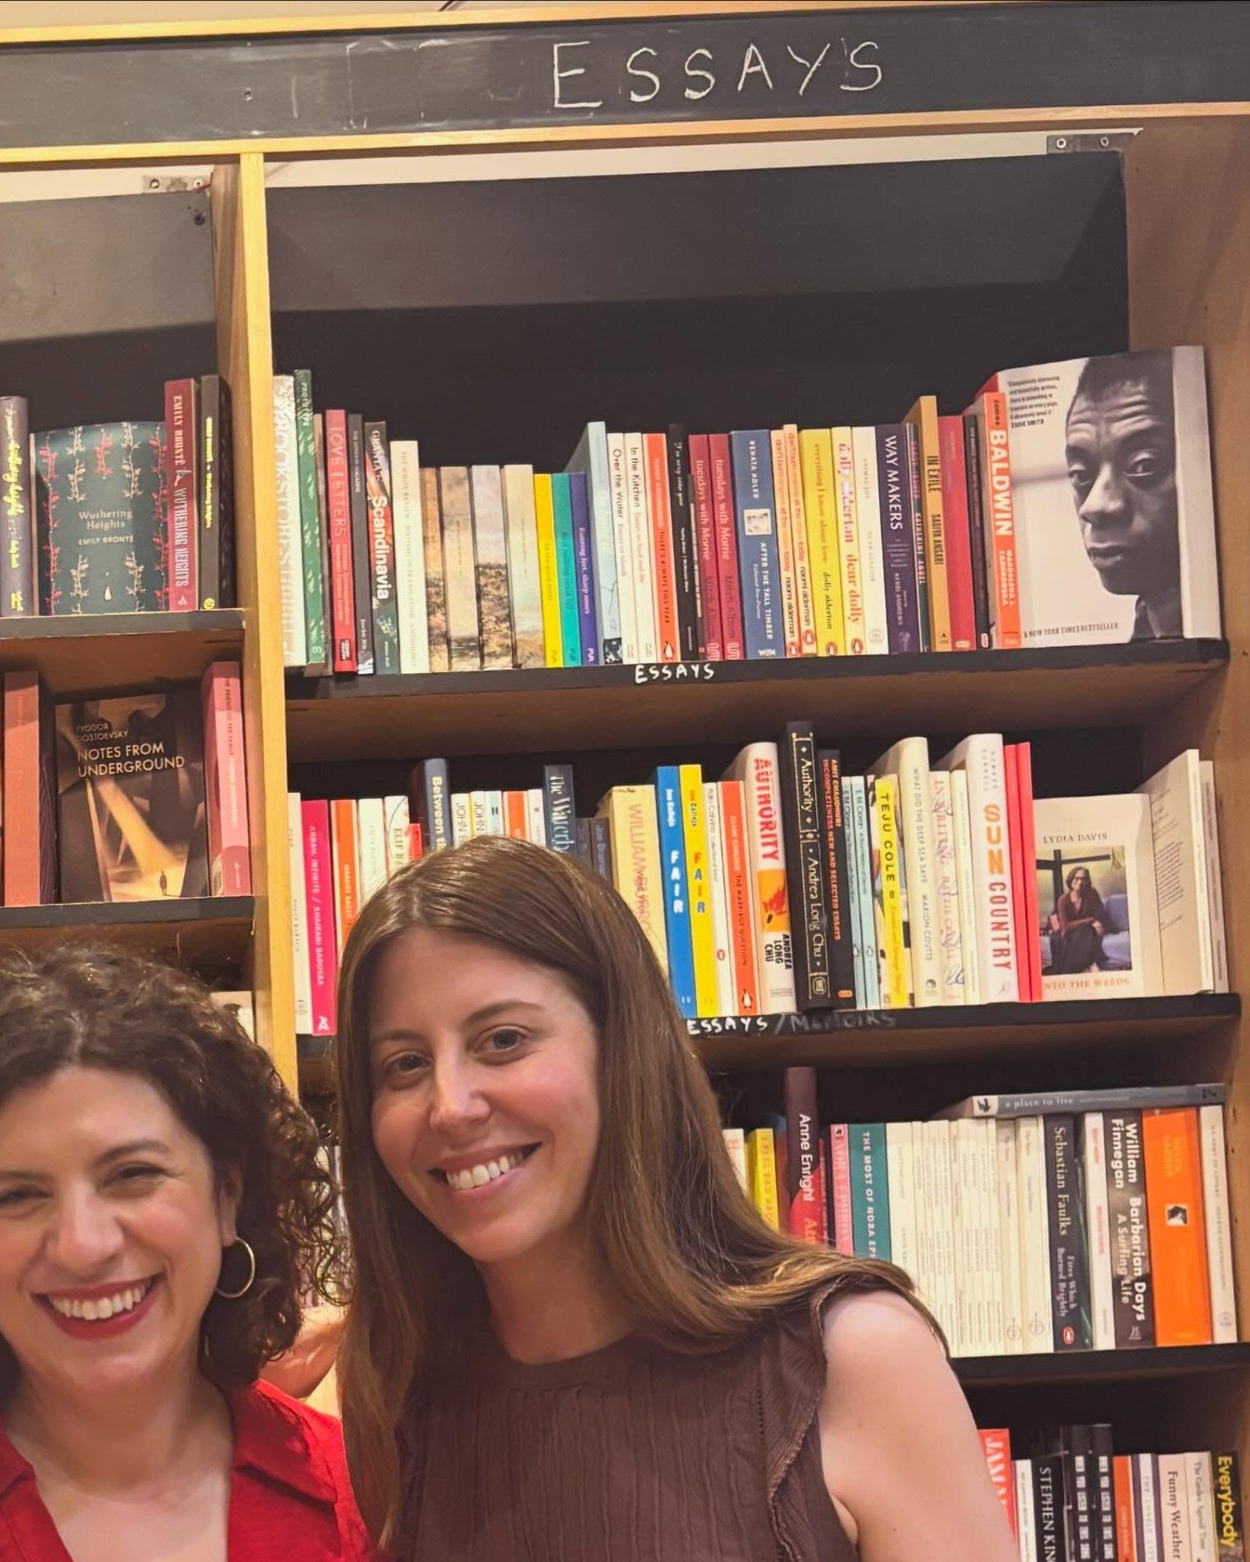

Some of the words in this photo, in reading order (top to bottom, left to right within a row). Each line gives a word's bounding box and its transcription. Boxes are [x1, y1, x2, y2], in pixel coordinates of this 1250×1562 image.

[552, 40, 883, 108] ESSAYS
[174, 395, 184, 425] EMILY
[301, 382, 309, 427] PROTOTYPE
[330, 427, 344, 465] LOVE
[371, 430, 381, 471] GRANTA
[613, 449, 623, 471] Over
[631, 447, 639, 456] In
[749, 440, 757, 471] RENATA
[838, 442, 851, 474] dolly
[884, 436, 899, 466] WAY
[927, 456, 939, 466] IN
[631, 457, 639, 471] the
[615, 474, 623, 487] the
[633, 474, 642, 507] Kitchen
[715, 460, 727, 500] tuesdays
[751, 473, 759, 499] ADLER
[928, 469, 940, 492] EXILE
[990, 430, 1012, 536] BALDWIN
[79, 509, 133, 521] Wuthering
[332, 473, 346, 537] LETTERS
[616, 492, 624, 518] Water
[718, 503, 729, 524] with
[841, 482, 855, 543] alderton
[888, 470, 902, 530] MAKERS
[86, 519, 125, 530] Heights
[174, 488, 188, 545] WUTHERING
[931, 514, 942, 538] SADIYA
[79, 536, 99, 545] EMILY
[372, 495, 391, 599] Scandinavia
[720, 527, 731, 560] Morrie
[760, 542, 768, 567] AFTER
[933, 540, 944, 564] ANSARI
[174, 548, 189, 587] HEIGHTS
[762, 570, 770, 585] THE
[846, 554, 858, 586] dear
[725, 575, 734, 603] Mitch
[763, 588, 771, 606] TALL
[726, 607, 737, 638] Albom
[848, 590, 861, 624] dolly
[765, 609, 773, 640] TIMBER
[635, 664, 714, 683] ESSAYS
[78, 747, 121, 762] NOTES
[125, 742, 164, 756] FROM
[78, 756, 185, 777] UNDERGROUND
[801, 759, 813, 812] Authority
[912, 768, 921, 791] WHAT
[432, 776, 444, 833] Between
[754, 759, 779, 861] AUTHORITY
[880, 794, 891, 832] TEJU
[914, 793, 922, 807] DID
[916, 826, 924, 846] DEEP
[983, 804, 1004, 876] SUN
[1043, 834, 1074, 844] LYDIA
[1077, 832, 1107, 842] DAVIS
[884, 840, 894, 882] COLE
[808, 857, 820, 899] Andrea
[809, 903, 823, 931] Long
[921, 894, 930, 928] MARION
[989, 882, 1011, 970] COUNTRY
[765, 944, 773, 962] CHU
[774, 940, 783, 964] LONG
[783, 934, 792, 970] ANDREA
[812, 933, 825, 957] Chu
[924, 930, 932, 961] COUTTS
[800, 1114, 812, 1150] Anne
[1054, 1127, 1067, 1188] Sebastian
[1111, 1119, 1125, 1188] Finnegan
[1126, 1123, 1139, 1183] William
[801, 1154, 814, 1202] Enright
[864, 1156, 873, 1184] MOST
[866, 1189, 874, 1202] OF
[867, 1207, 875, 1236] NORA
[1058, 1194, 1070, 1236] Faulks
[1118, 1214, 1126, 1224] A
[1118, 1227, 1130, 1275] Surfing
[1129, 1197, 1142, 1276] Barbarian
[1057, 1247, 1066, 1279] Burned
[1067, 1256, 1075, 1277] Fires
[1057, 1282, 1067, 1317] Brightly
[1068, 1280, 1077, 1309] Which
[1121, 1279, 1131, 1304] Life
[1134, 1282, 1146, 1321] Days
[1039, 1467, 1054, 1531] STEPHEN
[1167, 1471, 1180, 1507] Funny
[1217, 1456, 1237, 1547] Everybody
[1170, 1511, 1182, 1559] Weather
